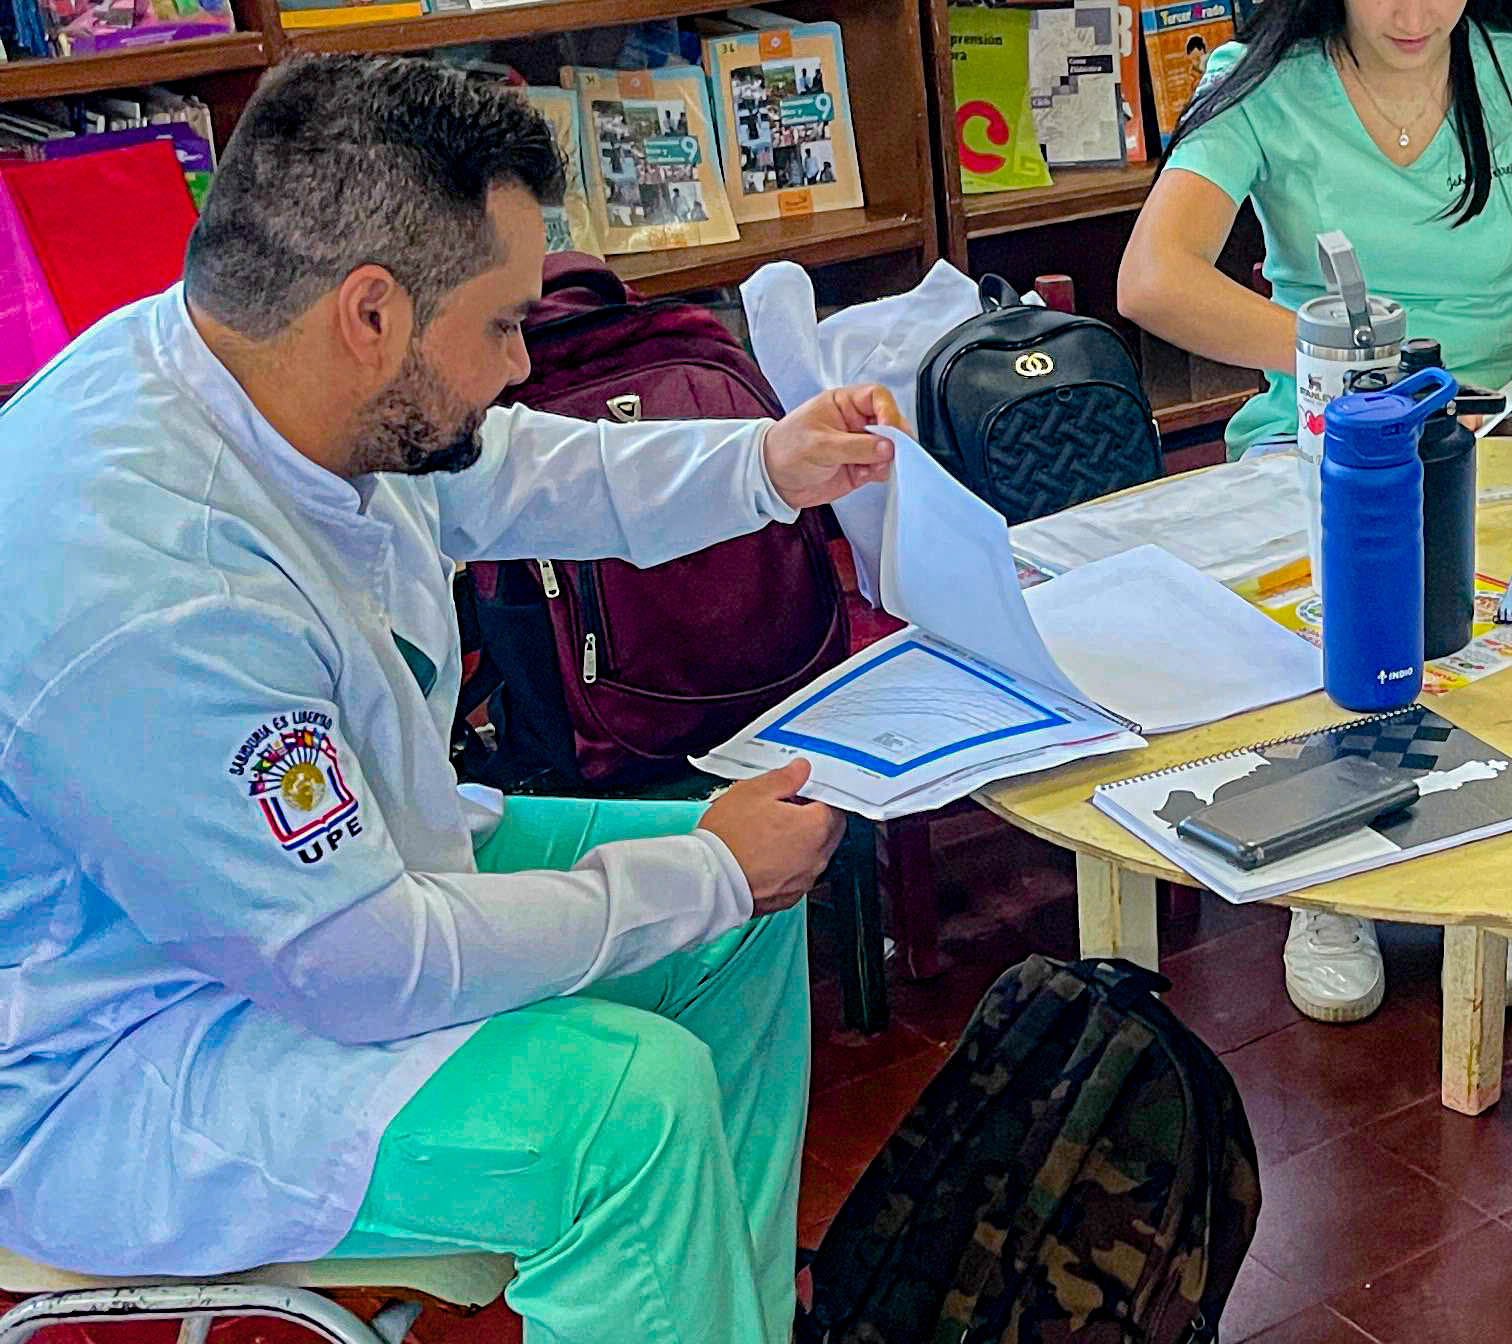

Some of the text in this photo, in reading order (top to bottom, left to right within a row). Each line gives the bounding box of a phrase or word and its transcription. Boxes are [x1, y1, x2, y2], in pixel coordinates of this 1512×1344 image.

[814, 92, 834, 121] 9
[679, 136, 699, 164] 9
[1299, 386, 1336, 404] STANLEY
[298, 816, 364, 864] UPE
